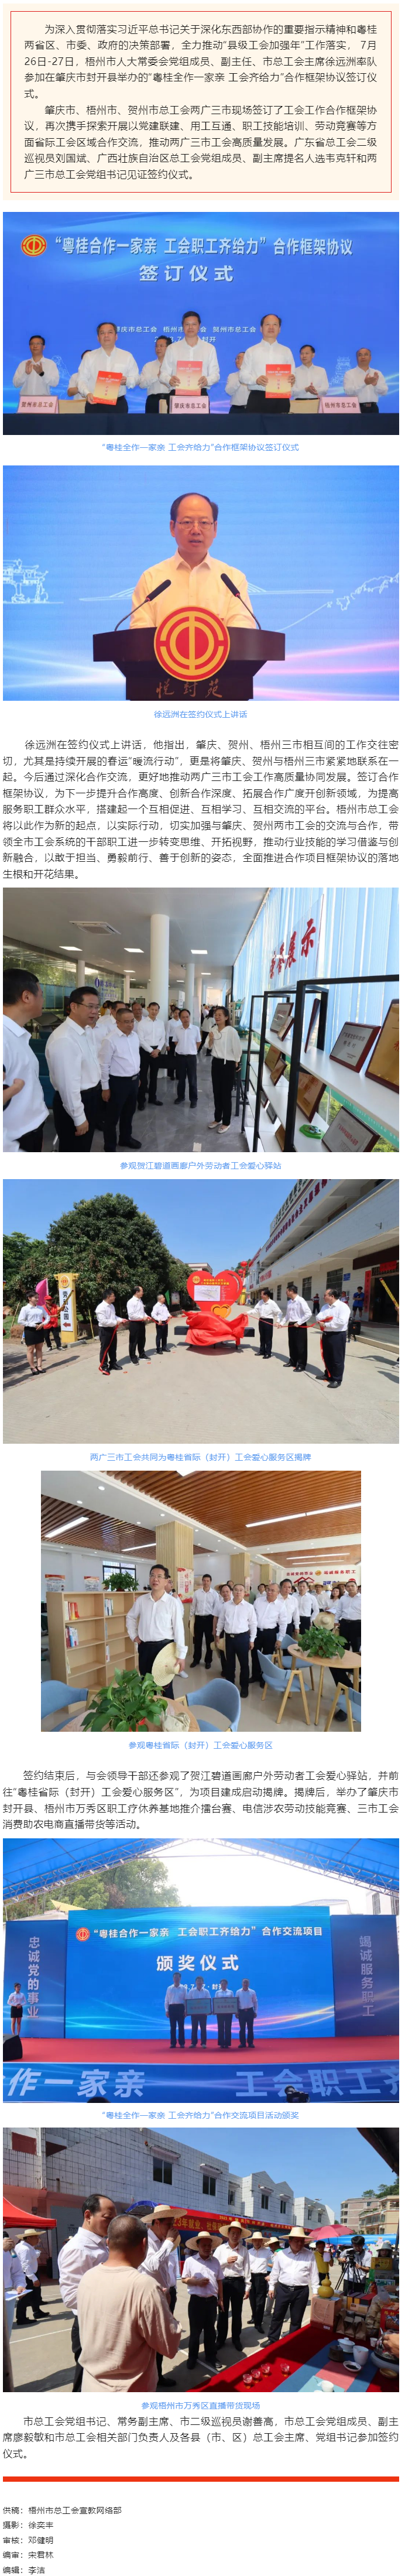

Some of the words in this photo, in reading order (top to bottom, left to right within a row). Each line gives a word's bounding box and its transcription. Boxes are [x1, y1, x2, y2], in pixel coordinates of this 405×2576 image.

[45, 24, 377, 35] 为深入贯彻落实习近平总书记关于深化东西部协作的重要指示精神和粤桂
[361, 40, 376, 50] 7月
[25, 56, 377, 67] 26日-27日，梧州市人大常委会党组成员、副主任、市总工会主席徐远洲率队
[24, 89, 39, 99] 式。
[44, 105, 377, 116] 肇庆市、梧州市、贺州市总工会两广三市现场签订了工会工作合作框架协
[24, 121, 377, 132] 议，再次携手探索开展以党建联建、用工互通、职工技能培训、劳动竞赛等方
[25, 137, 377, 148] 面省际工会区域合作交流，推动两广三市工会高质量发展。广东省总工会二级
[25, 153, 377, 164] 巡视员刘国斌、广西壮族自治区总工会党组成员、副主席提名人选韦克轩和两
[25, 169, 192, 180] 广三市总工会党组书记见证签约仪式。
[273, 238, 353, 255] 合作框架协议
[139, 265, 234, 282] 签订仪式
[25, 739, 399, 749] 徐远洲在签约仪式上讲话，他指出，肇庆、贺州、梧州三市相互间的工作交往密
[3, 772, 399, 782] 起。今后通过深化合作交流，更好地推动两广三市工会工作高质量协同发展。签订合作
[3, 788, 399, 799] 框架协议，为下一步提升合作高度、创新合作深度、拓展合作广度开创新领域，为提高
[3, 804, 399, 814] 服务职工群众水平，搭建起一个互相促进、互相学习、互相交流的平台。梧州市总工会
[3, 820, 399, 831] 将以此作为新的起点，以实际行动，切实加强与肇庆、贺州两市工会的交流与合作，带
[3, 837, 399, 847] 领全市工会系统的干部职工进一步转变思维、开拓视野，推动行业技能的学习借鉴与创
[3, 852, 399, 863] 新融合，以敢于担当、勇毅前行、善于创新的姿态，全面推进合作项目框架协议的落地
[3, 869, 78, 879] 生根和开花结果。
[23, 1770, 399, 1781] 签约结束后，与会领导干部还参观了贺江碧道画廊户外劳动者工会爱心驿站，并前
[3, 1803, 399, 1813] 封开县、梧州市万秀区职工疗休养基地推介擂台赛、电信涉农劳动技能竞赛、三市工会
[3, 1819, 140, 1829] 消费助农电商直播带货等活动。
[262, 1926, 322, 1936] 合作交流项目
[156, 1954, 239, 1972] 颁奖仪式
[27, 1936, 40, 2019] 忠诚党的事业
[359, 1936, 375, 2017] 竭诚服务职工
[3, 2067, 145, 2098] 作一家亲
[23, 2416, 399, 2427] 市总工会党组书记、常务副主席、市二级巡视员谢善高，市总工会党组成员、副主
[3, 2432, 399, 2443] 席廖毅敏和市总工会相关部门负责人及各县（市、区）总工会主席、党组书记参加签约
[3, 2449, 27, 2459] 仪式。
[3, 2566, 45, 2574] 编辑：李洁
